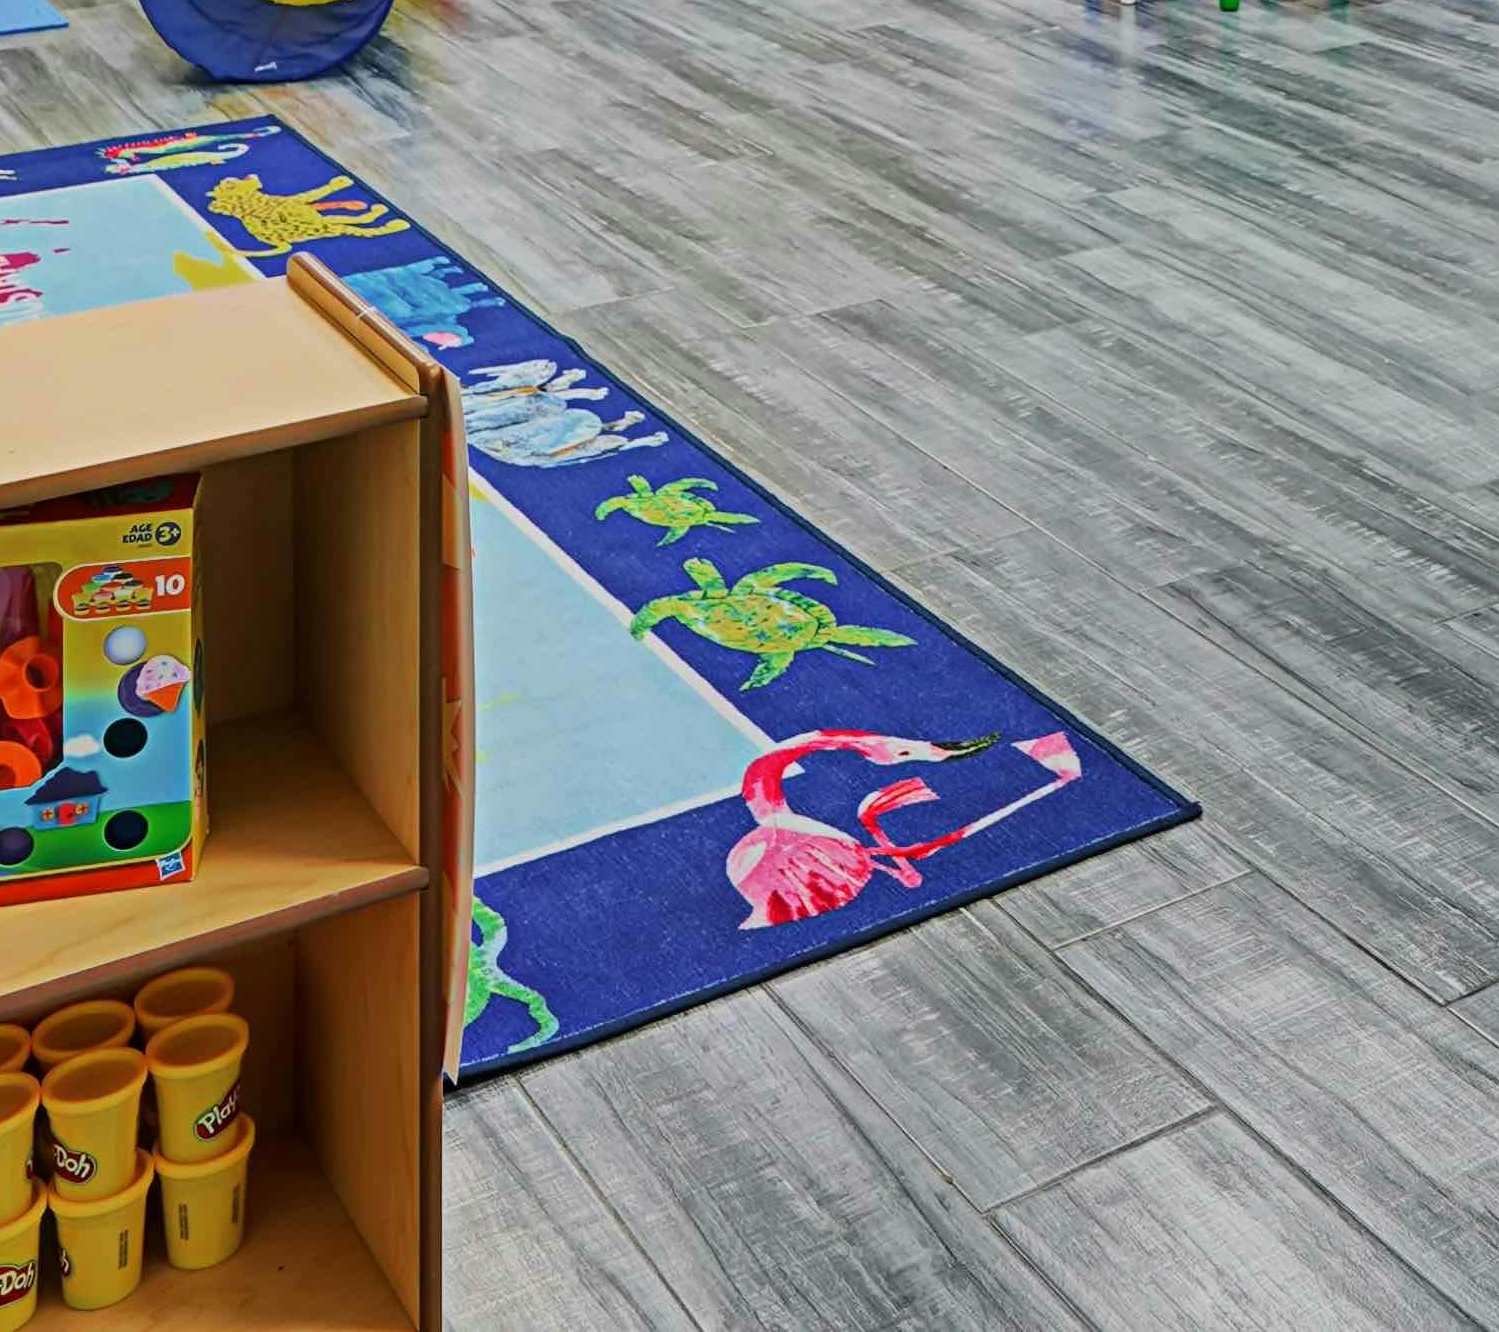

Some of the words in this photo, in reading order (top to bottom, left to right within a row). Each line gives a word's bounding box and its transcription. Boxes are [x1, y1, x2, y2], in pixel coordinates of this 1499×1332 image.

[129, 523, 153, 533] AGE
[157, 525, 181, 543] 3+
[122, 533, 153, 544] EDAD
[155, 574, 185, 597] 10
